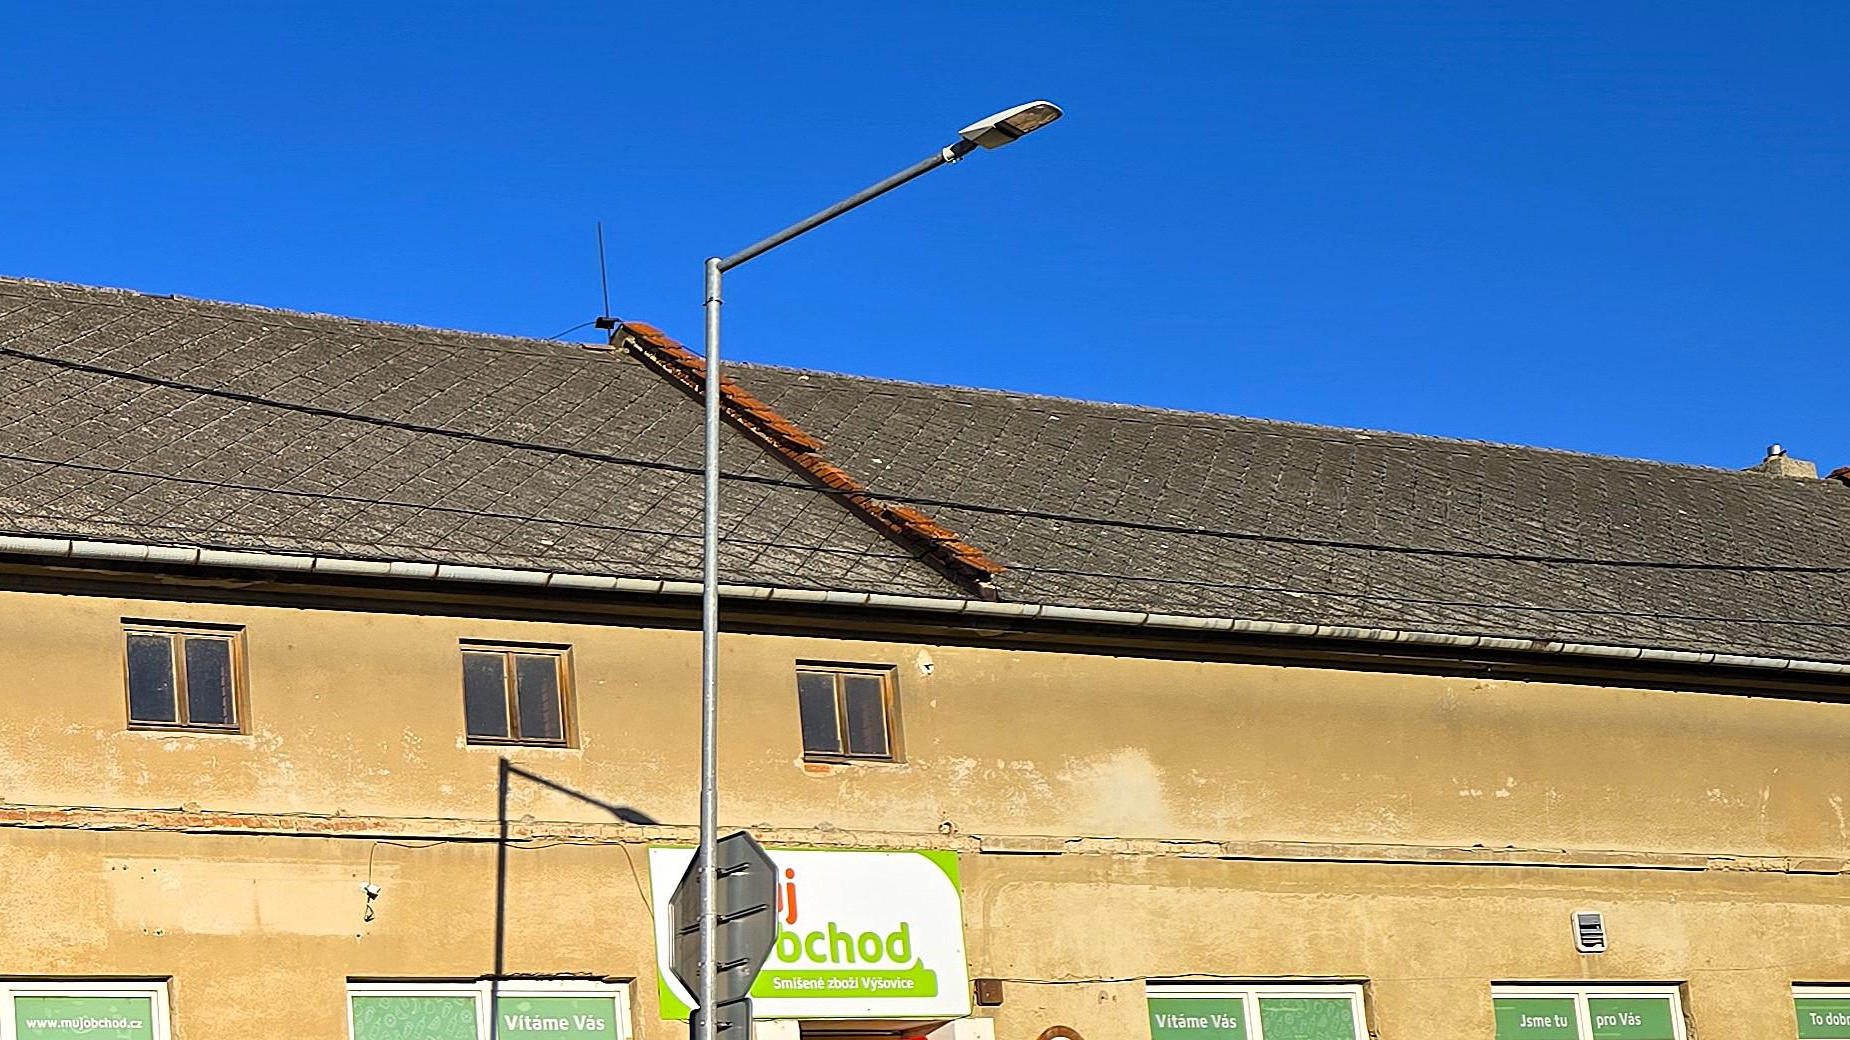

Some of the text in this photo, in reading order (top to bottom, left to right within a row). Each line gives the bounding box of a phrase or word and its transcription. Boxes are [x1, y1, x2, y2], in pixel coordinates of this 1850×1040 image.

[777, 922, 911, 963] bchod
[861, 976, 914, 991] Výšovice
[26, 1016, 143, 1030] www.mujobchod.cz
[503, 1014, 606, 1031] Vítáme Vás
[1154, 1013, 1237, 1029] Vítáme Vás
[1520, 1012, 1642, 1029] Jsme tu pro Vás
[1809, 1012, 1824, 1026] To
